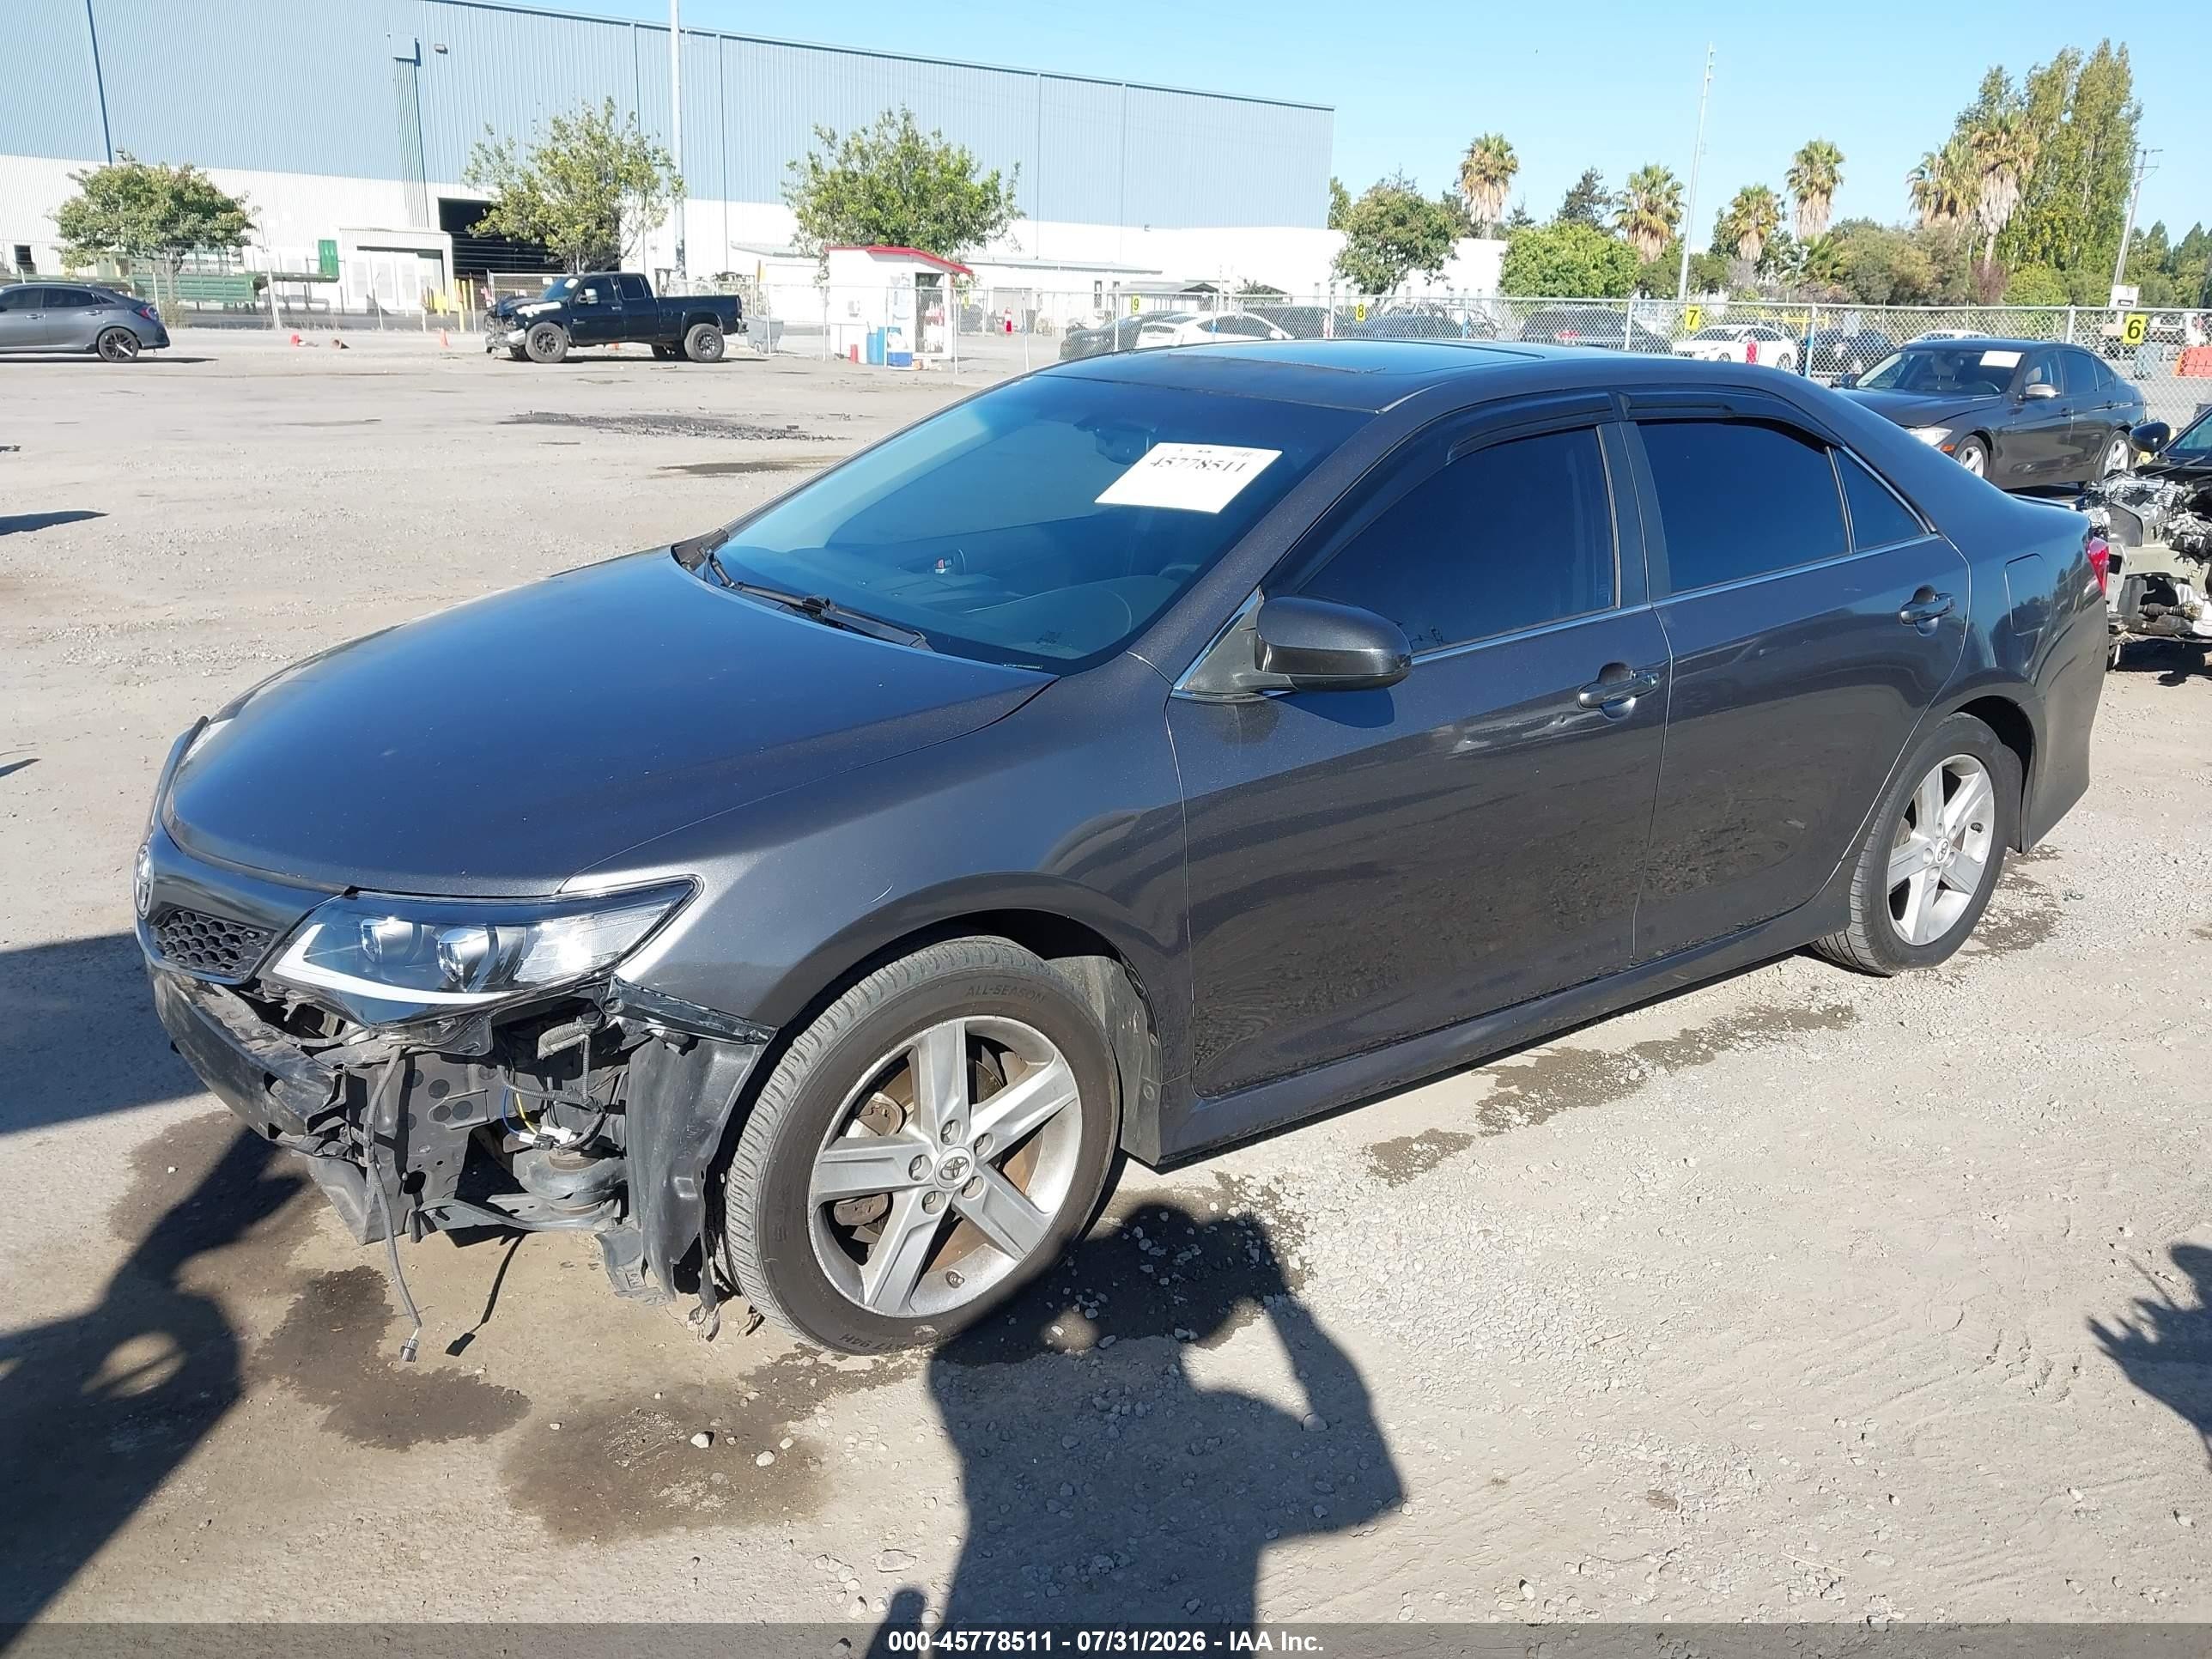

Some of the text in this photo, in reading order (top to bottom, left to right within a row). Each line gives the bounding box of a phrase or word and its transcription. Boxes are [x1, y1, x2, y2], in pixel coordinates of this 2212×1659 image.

[1133, 297, 1139, 311] 9
[1358, 304, 1364, 318] 8
[1688, 309, 1698, 326] 7
[2127, 319, 2142, 339] 6
[1149, 455, 1247, 472] 45778511
[965, 984, 1045, 1004] ALL-SEASON
